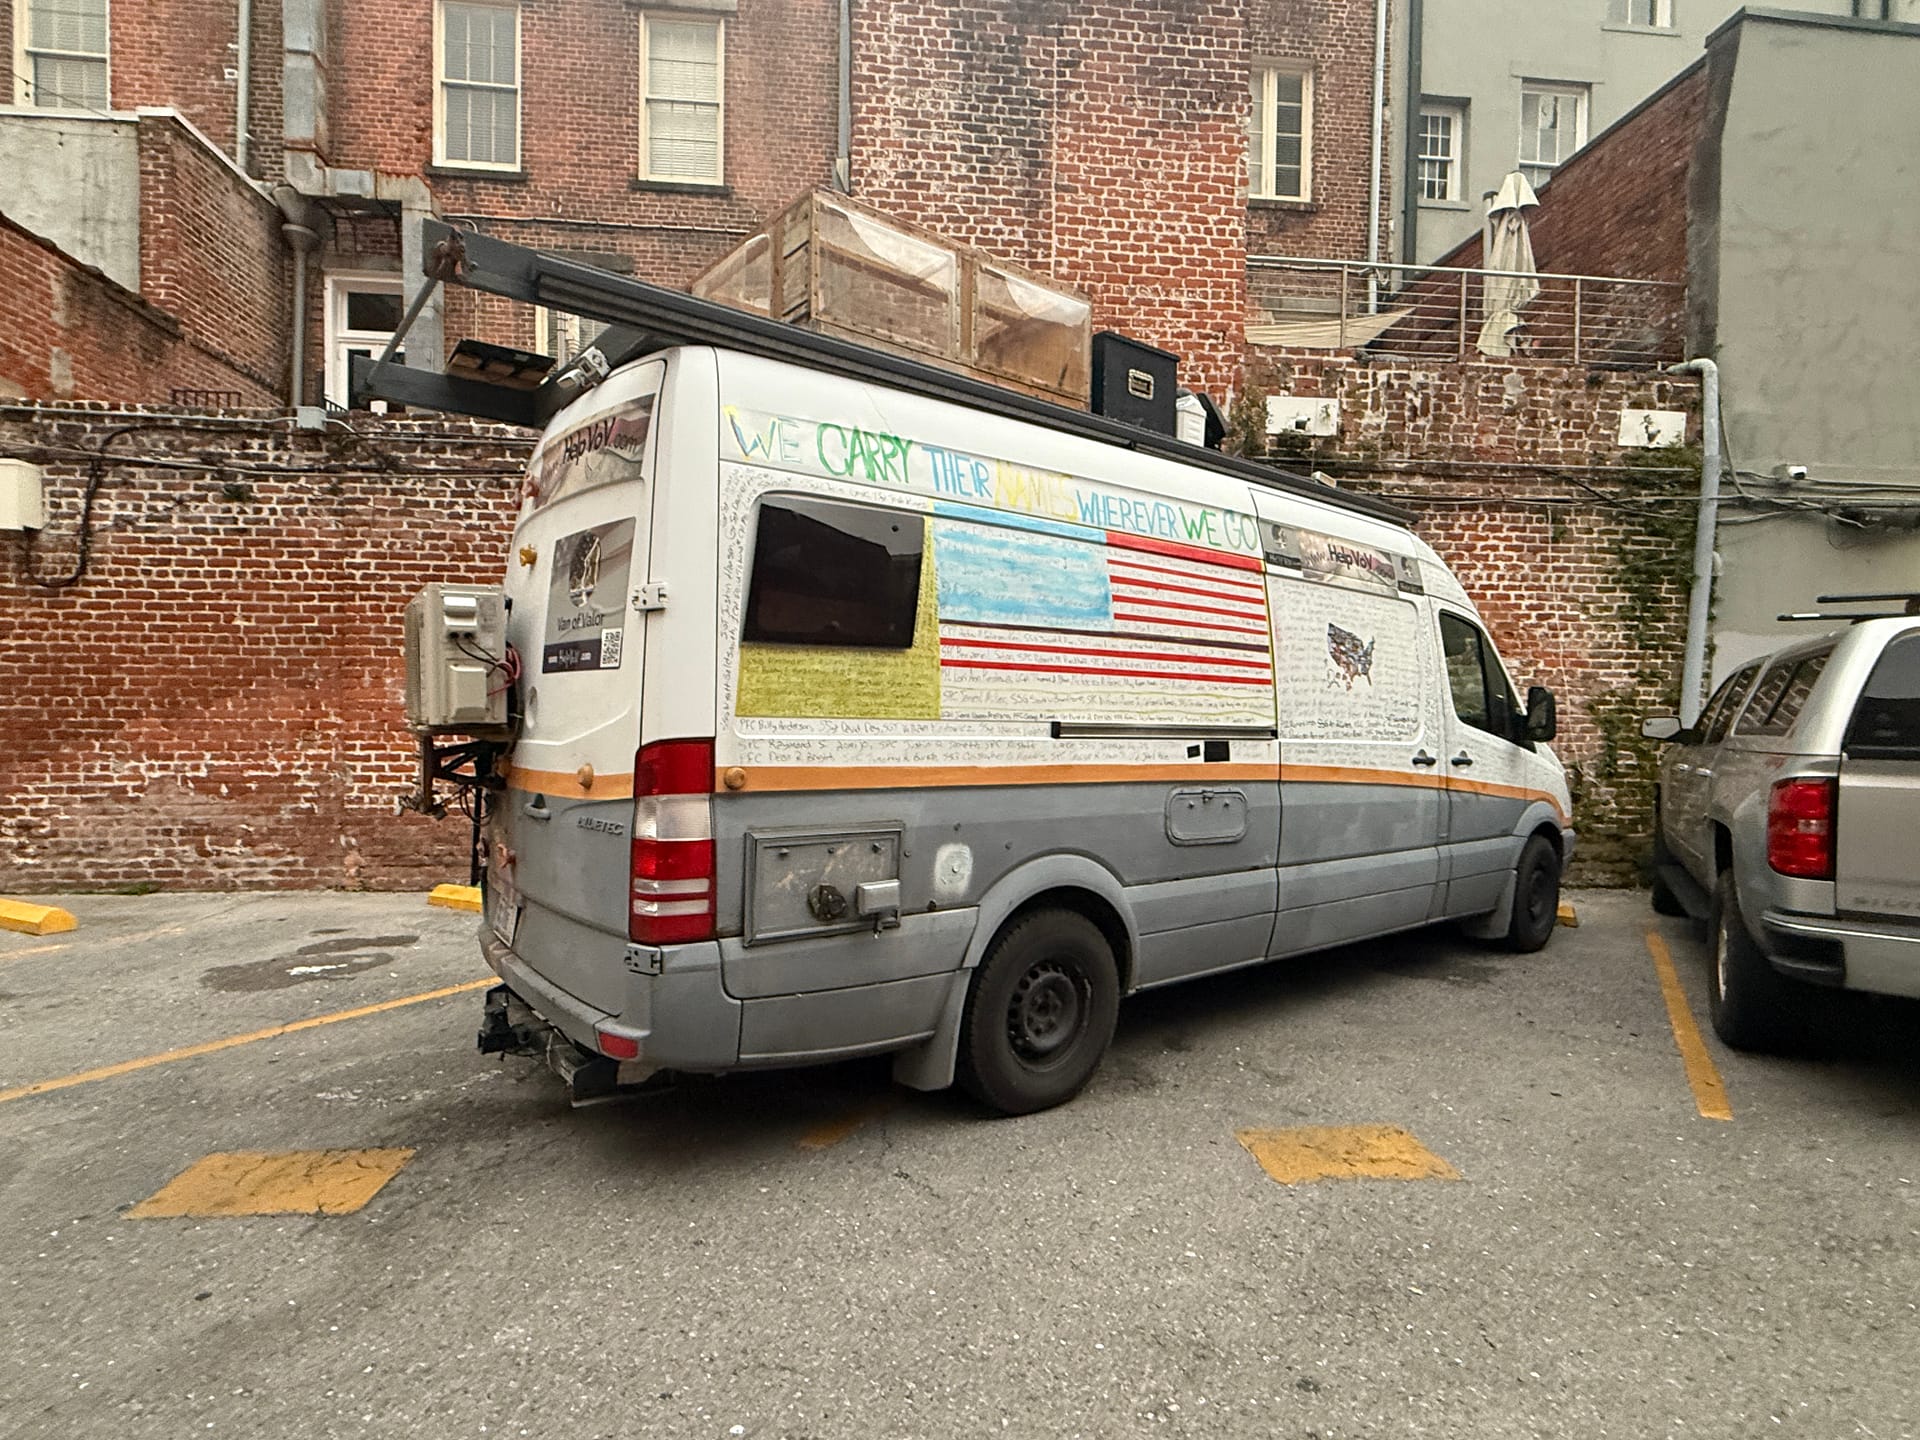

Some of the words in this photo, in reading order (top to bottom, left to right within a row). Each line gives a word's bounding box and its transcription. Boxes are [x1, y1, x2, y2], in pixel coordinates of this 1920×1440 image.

[724, 406, 802, 464] WE
[816, 422, 913, 484] CARRY
[1075, 488, 1180, 539] WHEREVER
[1178, 506, 1222, 547] WE
[1222, 508, 1258, 551] GO
[557, 616, 571, 631] Van
[581, 611, 606, 629] Valor
